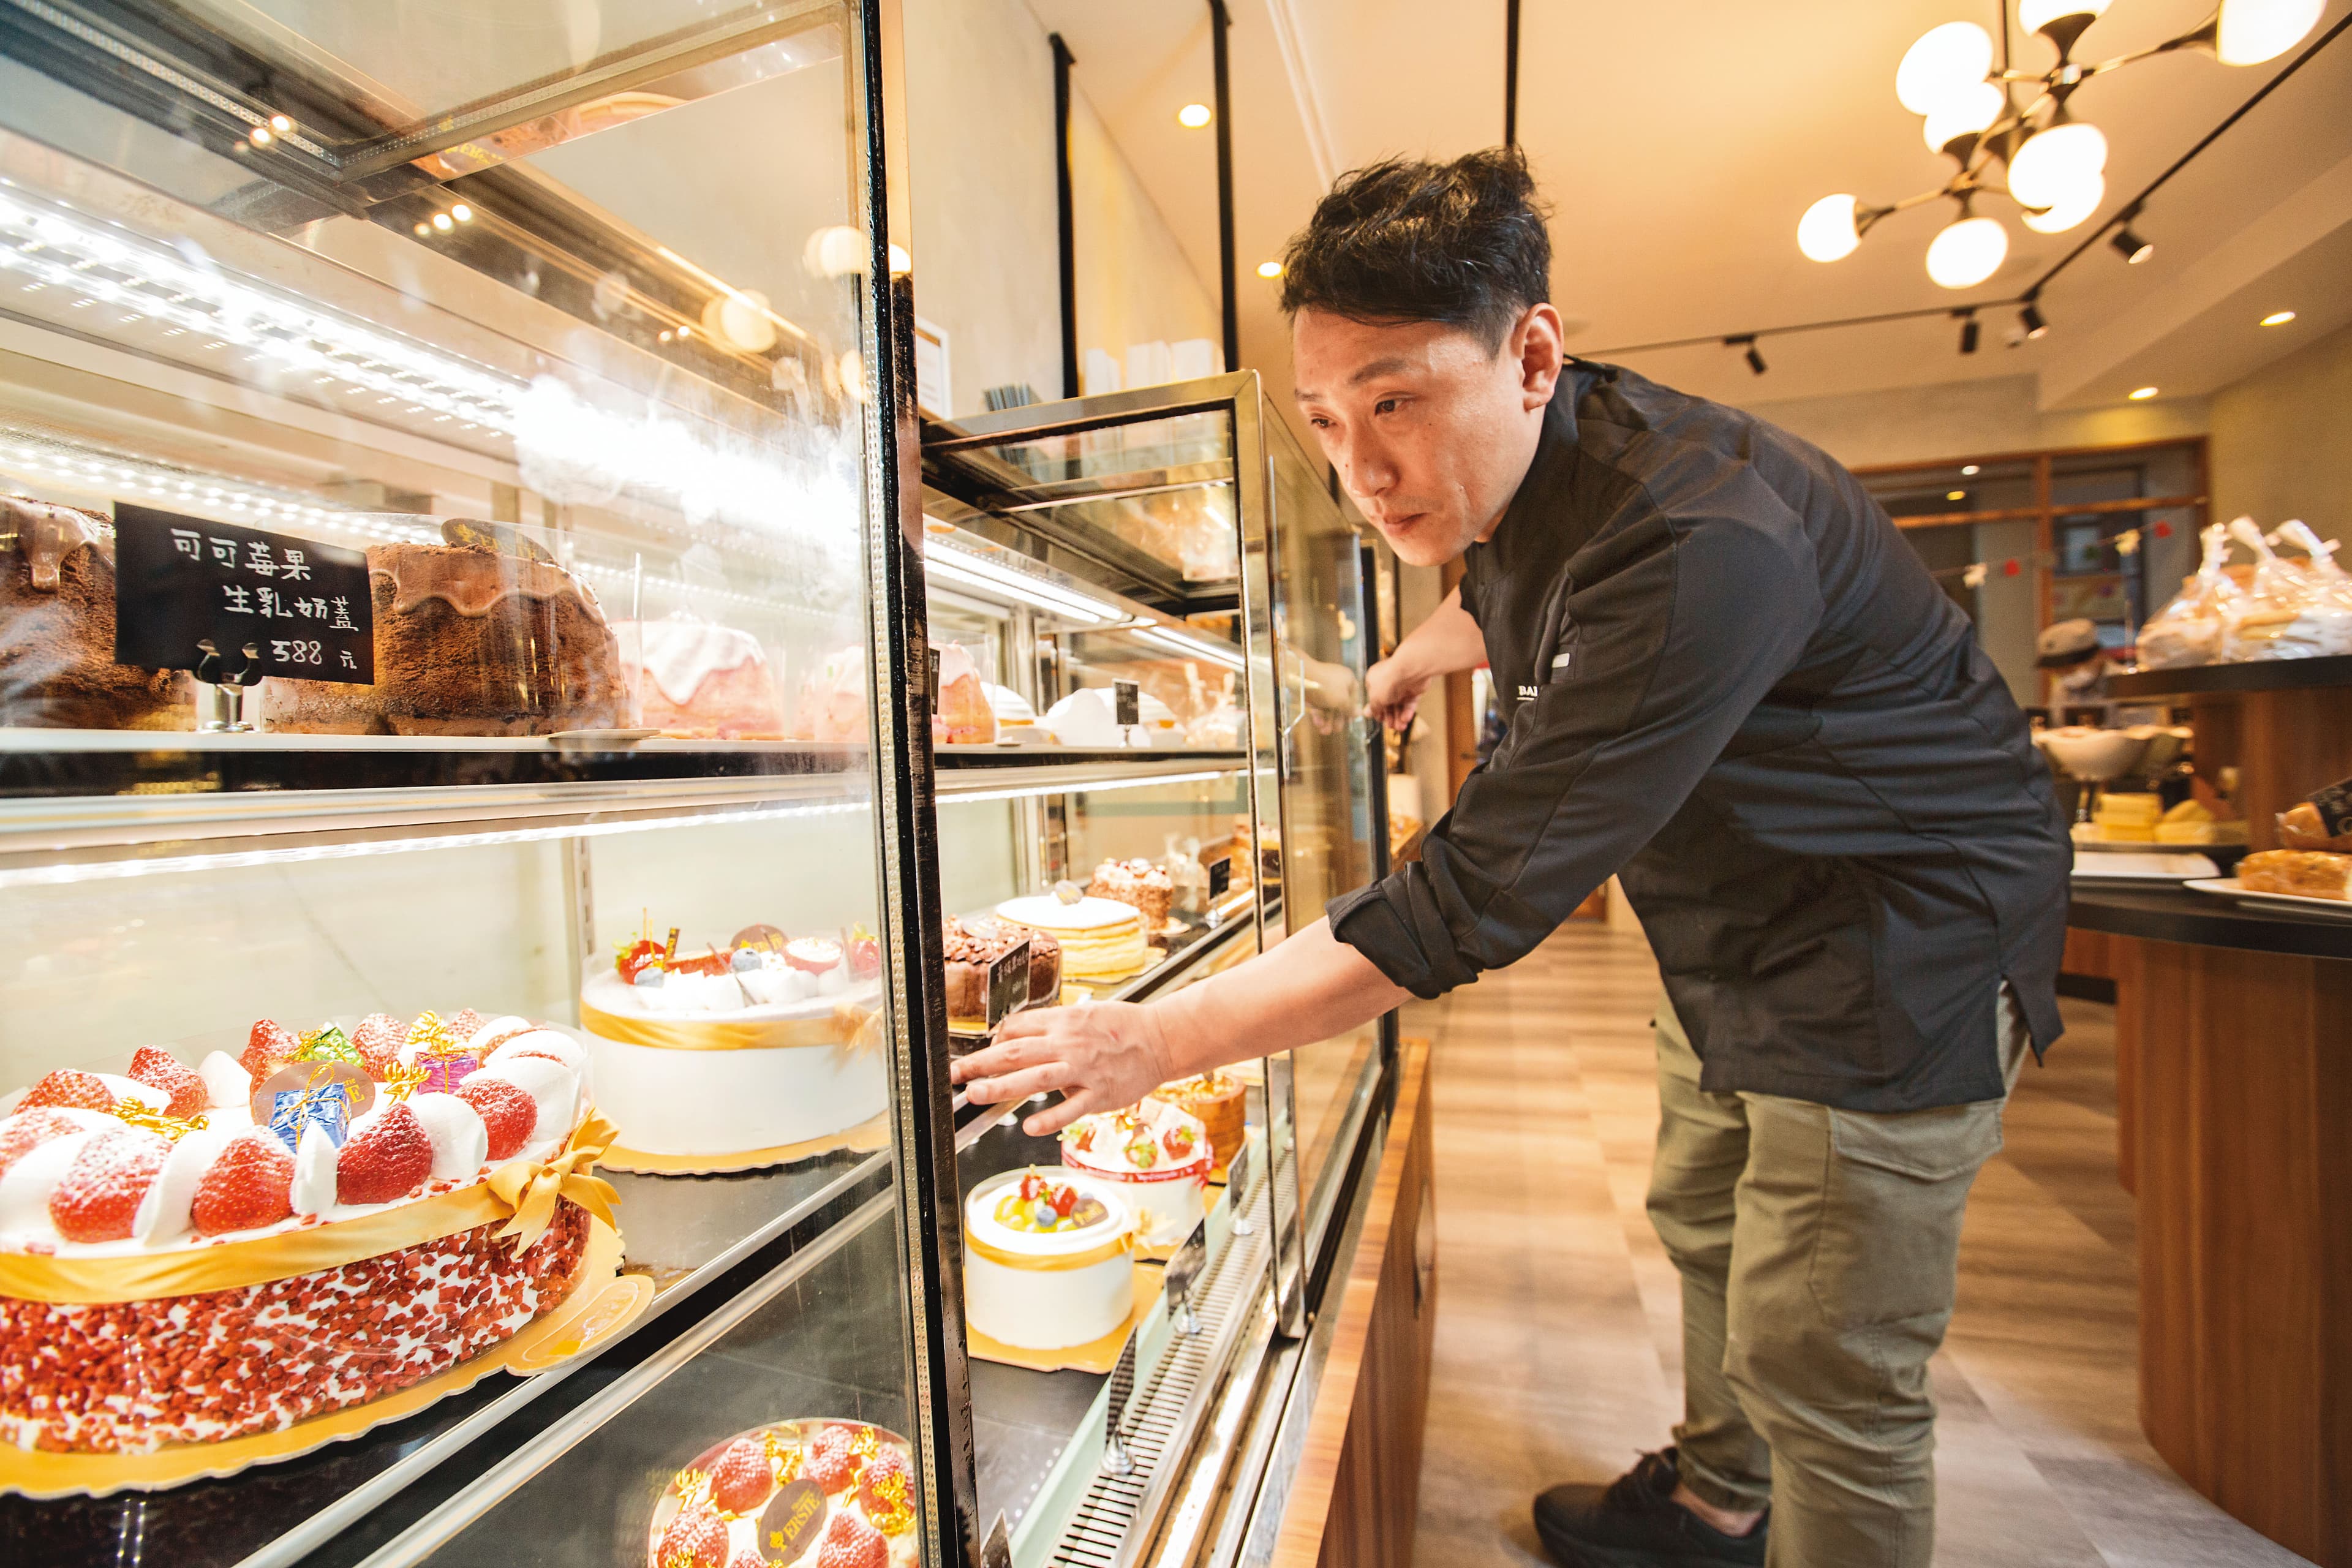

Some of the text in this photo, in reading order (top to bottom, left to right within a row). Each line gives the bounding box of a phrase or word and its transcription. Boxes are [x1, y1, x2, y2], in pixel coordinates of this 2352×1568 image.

[222, 584, 360, 631] 生乳奶蓋
[271, 640, 357, 669] 588 元
[783, 1493, 820, 1541] ERSTE
